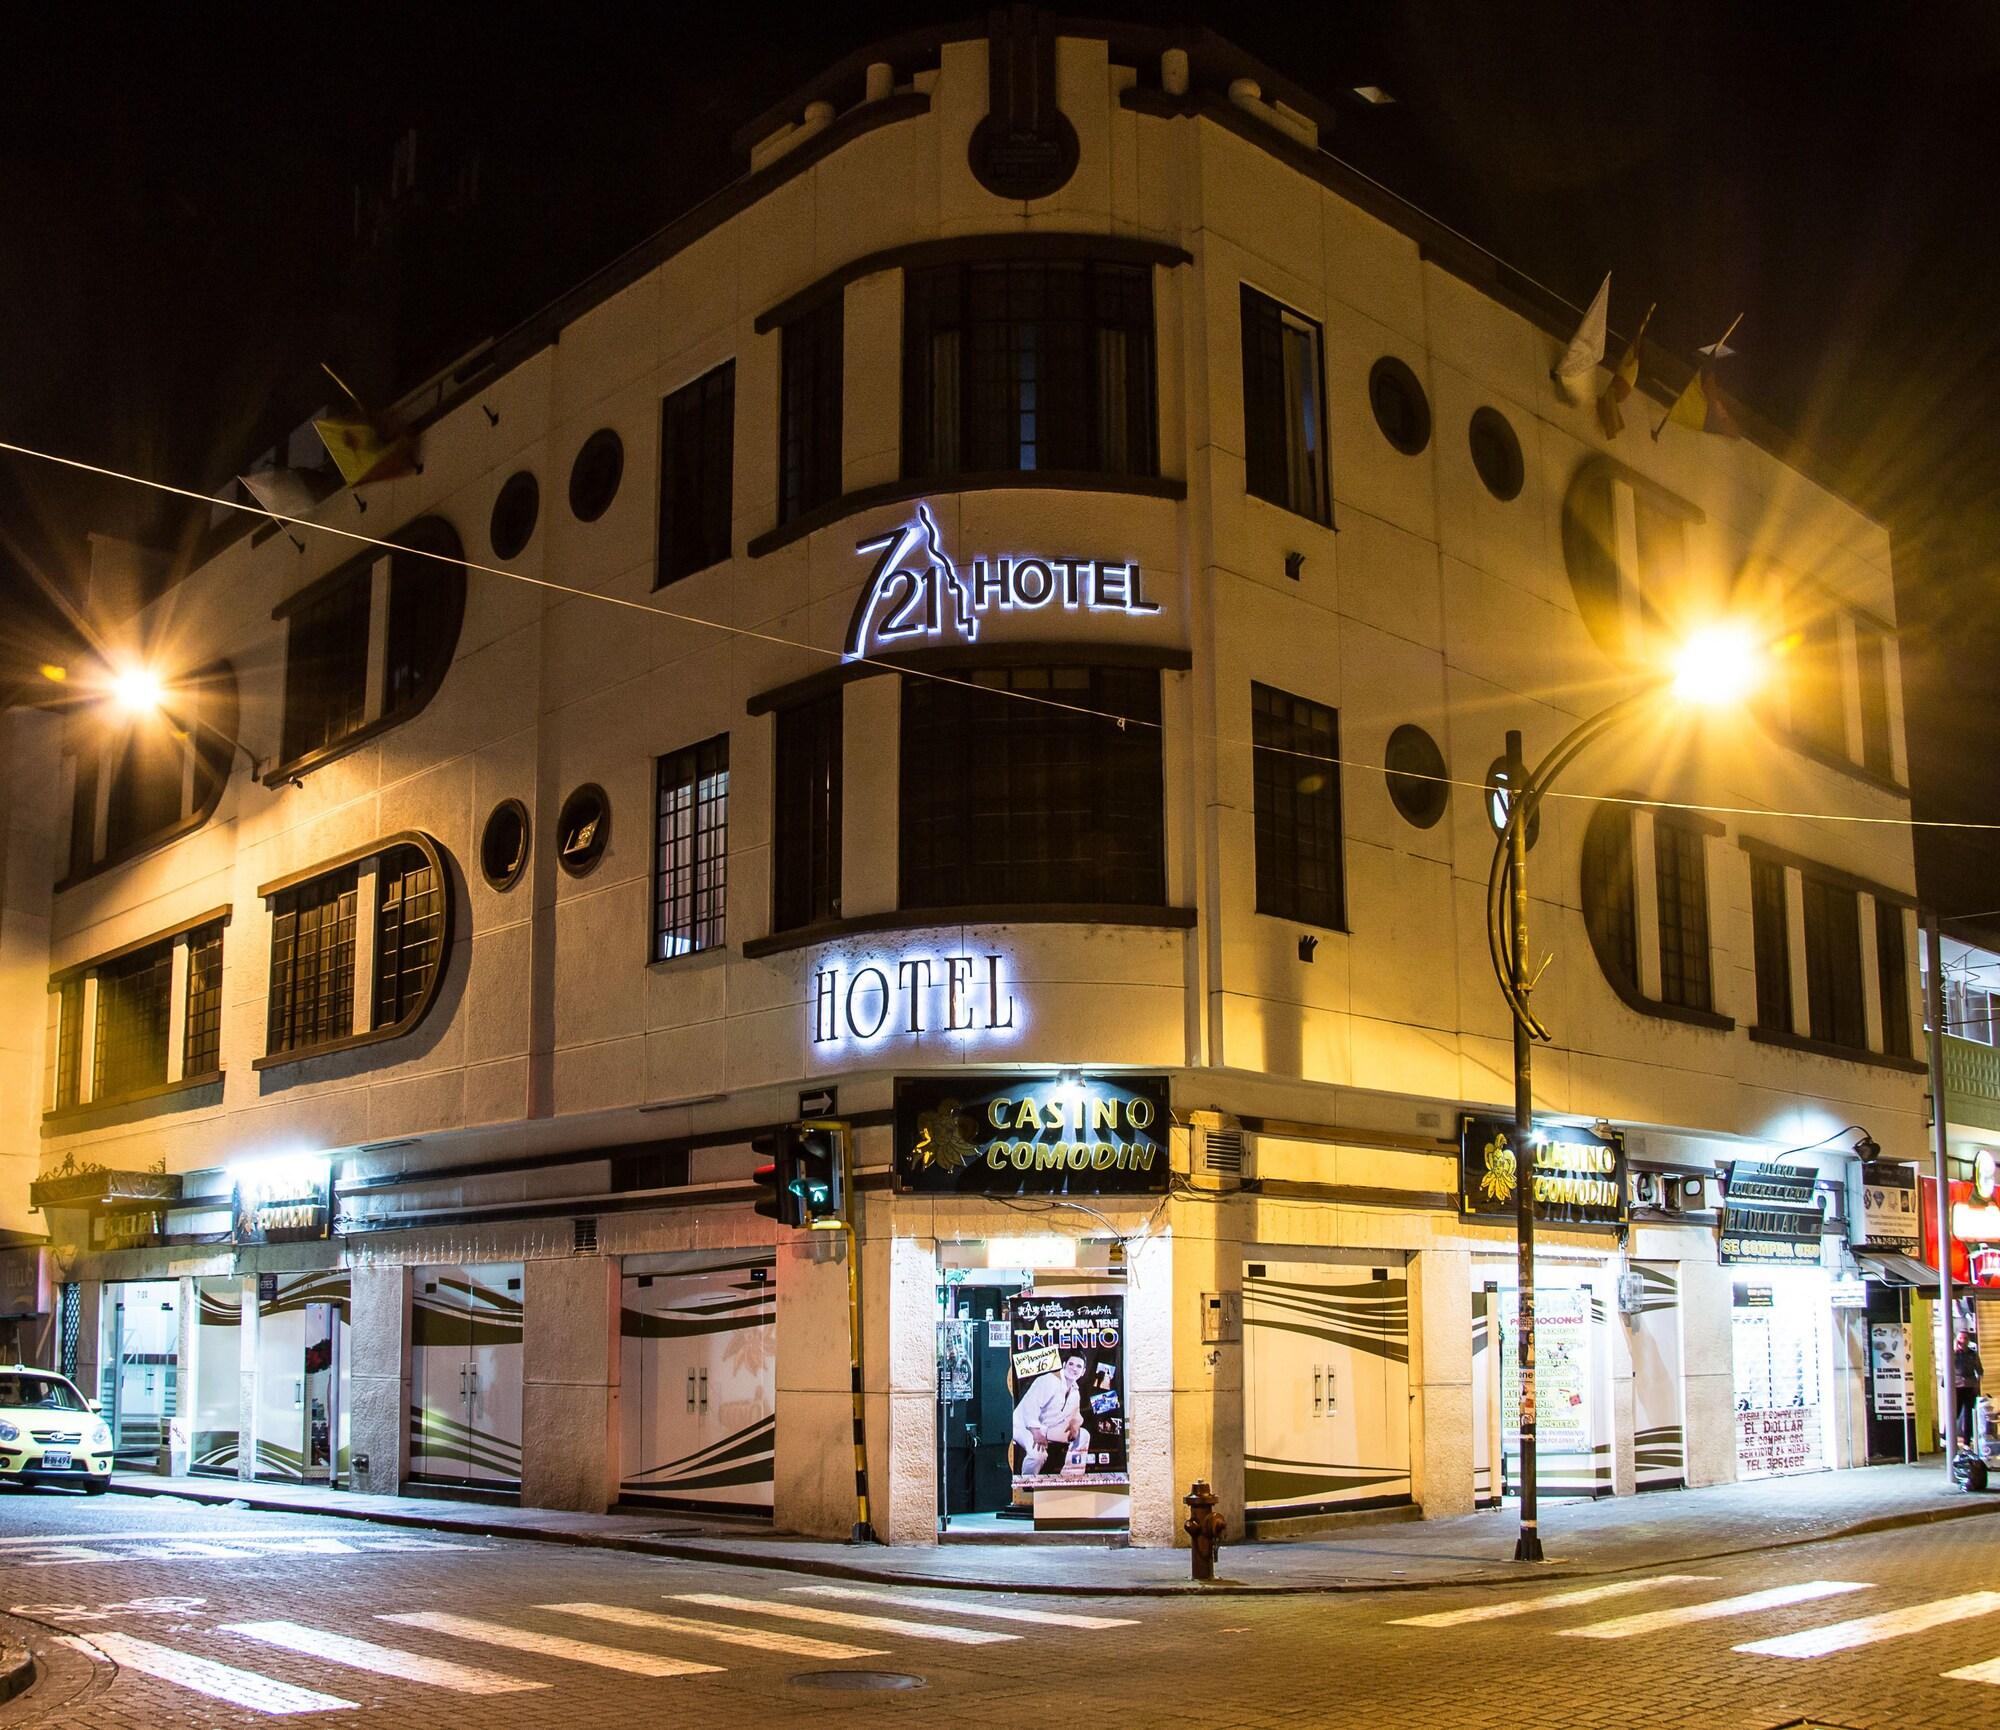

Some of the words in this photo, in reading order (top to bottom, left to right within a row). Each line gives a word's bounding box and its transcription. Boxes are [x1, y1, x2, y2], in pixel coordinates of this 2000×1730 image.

[973, 558, 1160, 614] HOTEL
[814, 955, 1013, 1043] HOTEL
[988, 1097, 1155, 1129] CASINO
[986, 1142, 1156, 1171] COMODIN
[1534, 1176, 1619, 1207] COMODIN
[1722, 1239, 1740, 1255] SE
[1741, 1240, 1794, 1257] COMPRA
[1046, 1320, 1094, 1330] COLOMBIA
[1095, 1318, 1119, 1328] TIENE
[1744, 1422, 1757, 1434] EL
[1763, 1420, 1804, 1433] DOLLAR
[1745, 1437, 1755, 1446] SE
